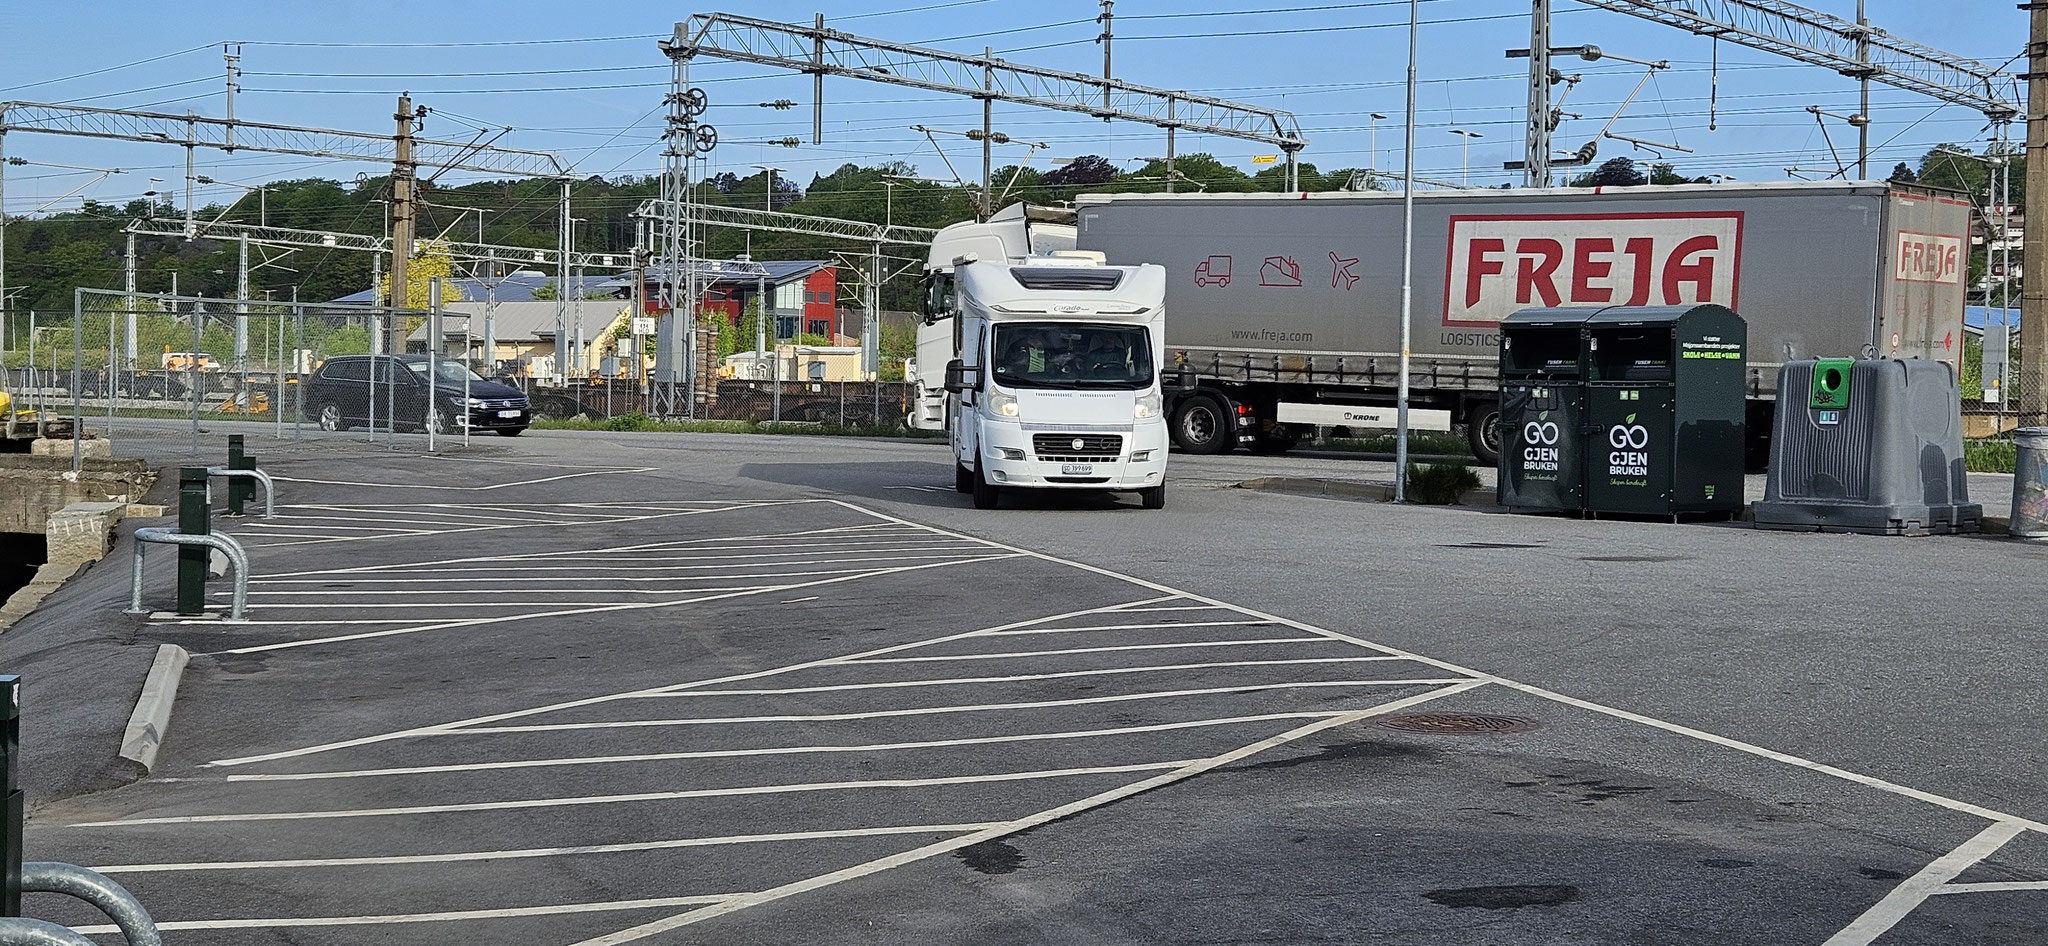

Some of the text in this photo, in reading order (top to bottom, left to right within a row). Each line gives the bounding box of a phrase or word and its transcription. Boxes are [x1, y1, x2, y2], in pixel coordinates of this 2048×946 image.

[1901, 241, 1957, 279] FREJA
[1465, 235, 1719, 309] FREJA
[1231, 328, 1313, 343] www.freja.com
[1440, 332, 1500, 347] LOGISTICS
[1524, 421, 1559, 445] GO
[1609, 424, 1649, 449] GO
[1523, 447, 1559, 461] GJEN
[1609, 452, 1648, 466] GJEN
[1523, 461, 1558, 471] BRUKEN
[1609, 466, 1648, 476] BRUKEN
